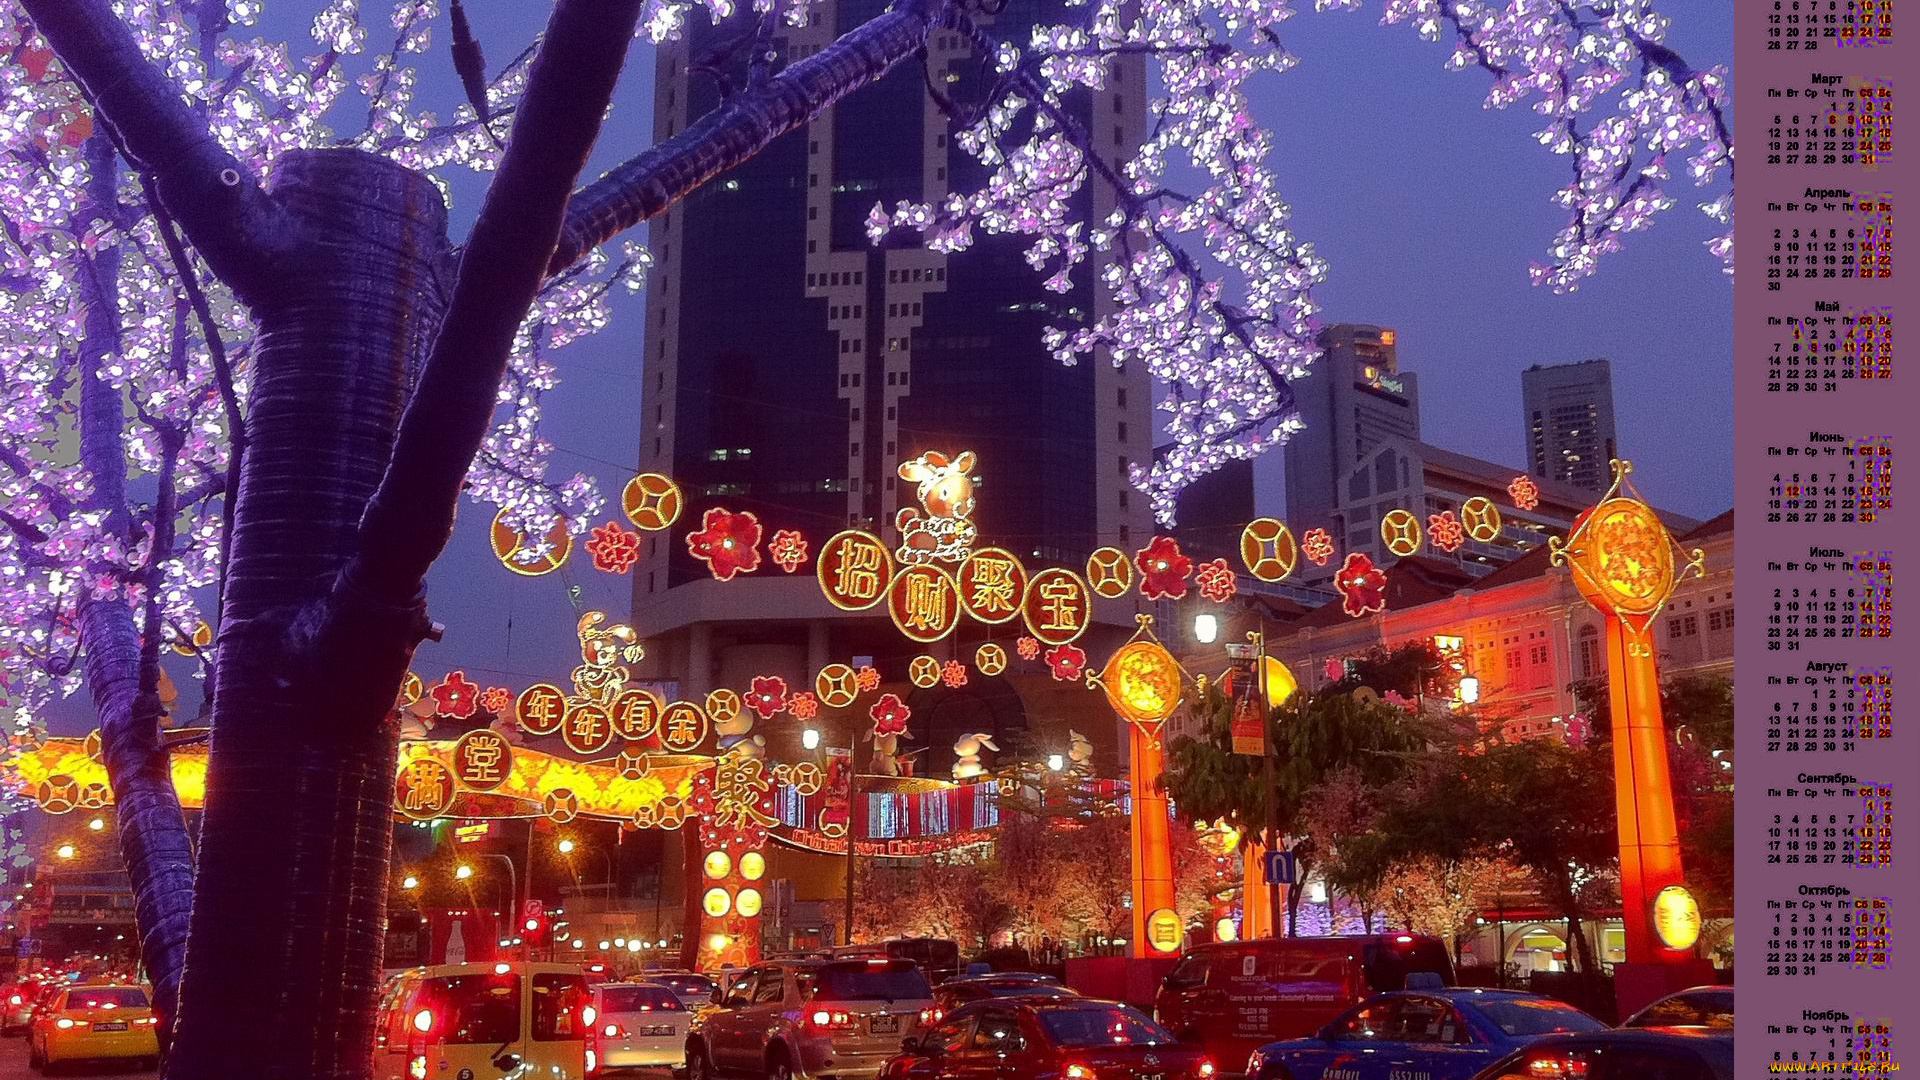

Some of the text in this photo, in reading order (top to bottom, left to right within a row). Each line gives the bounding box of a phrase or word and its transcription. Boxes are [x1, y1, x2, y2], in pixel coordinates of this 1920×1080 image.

[835, 537, 1079, 633] 招财聚宝
[526, 689, 698, 746] 年年有余
[711, 752, 780, 830] 聚
[462, 1070, 469, 1079] 5
[1323, 1067, 1360, 1080] Comfort
